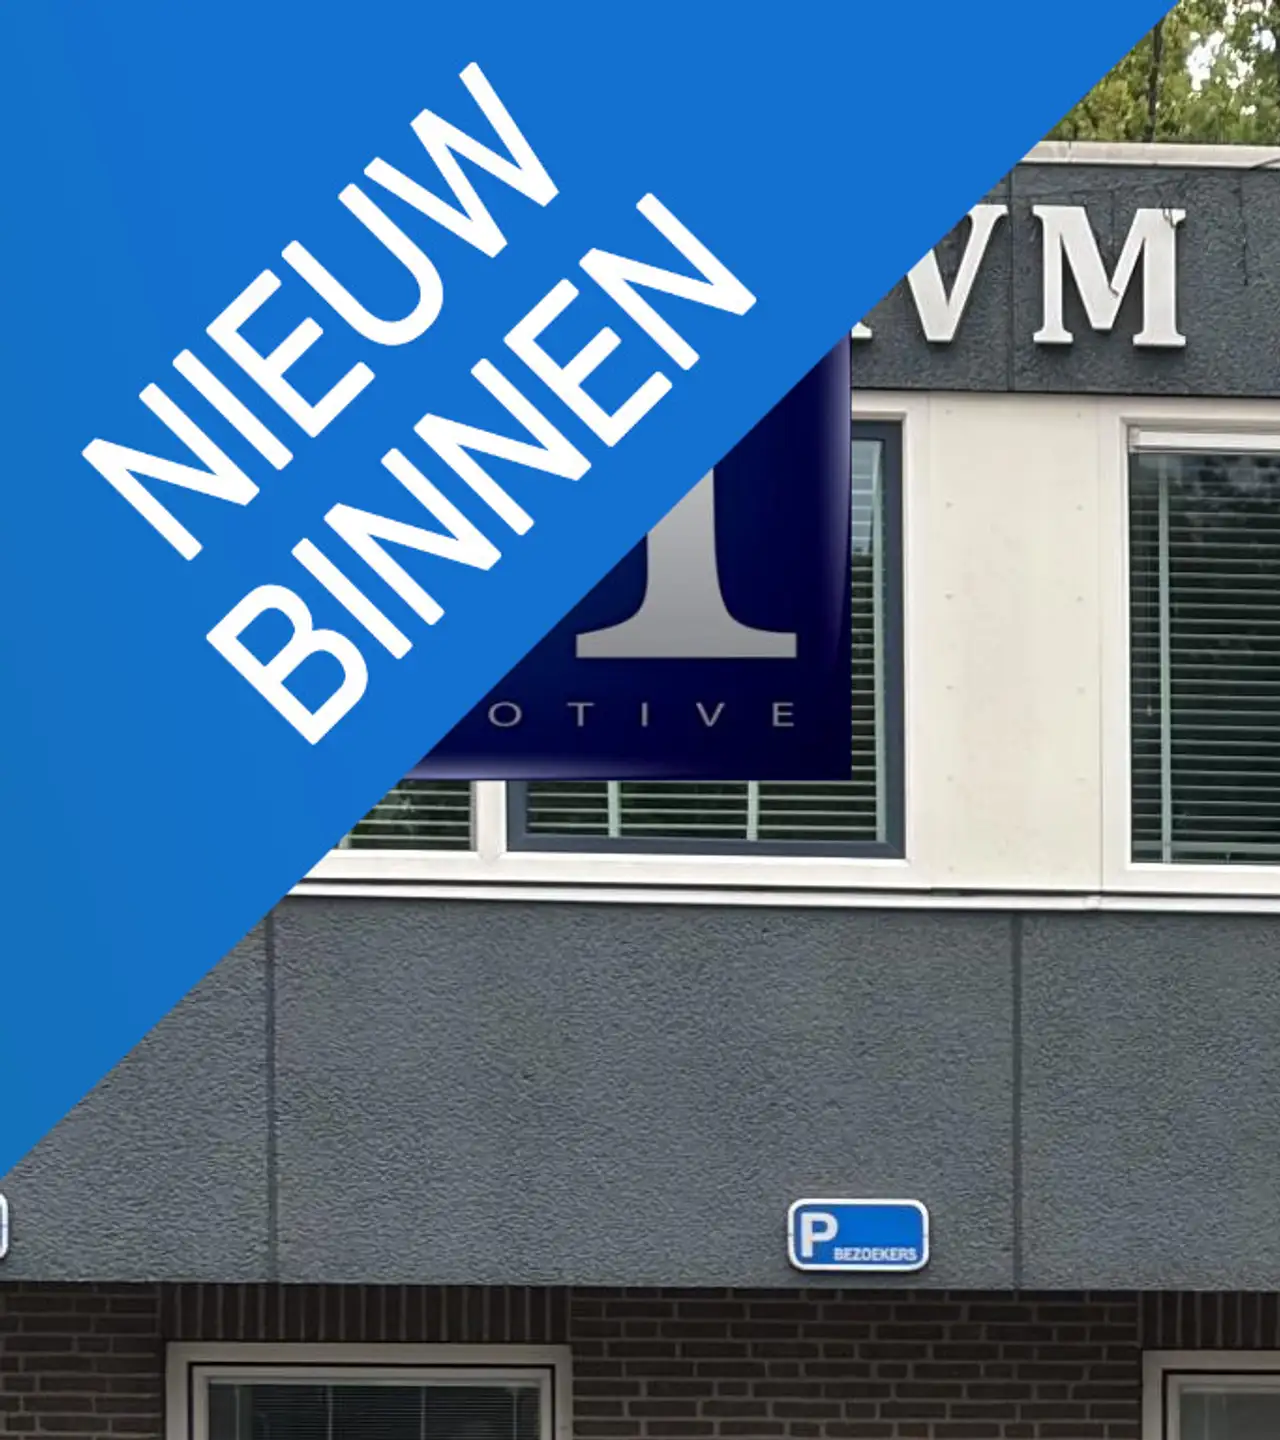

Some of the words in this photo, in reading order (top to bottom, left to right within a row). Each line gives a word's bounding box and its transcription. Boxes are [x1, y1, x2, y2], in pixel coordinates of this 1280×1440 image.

[851, 204, 1187, 347] VM
[801, 1212, 838, 1258] P
[834, 1247, 918, 1262] BEZOEKERS
